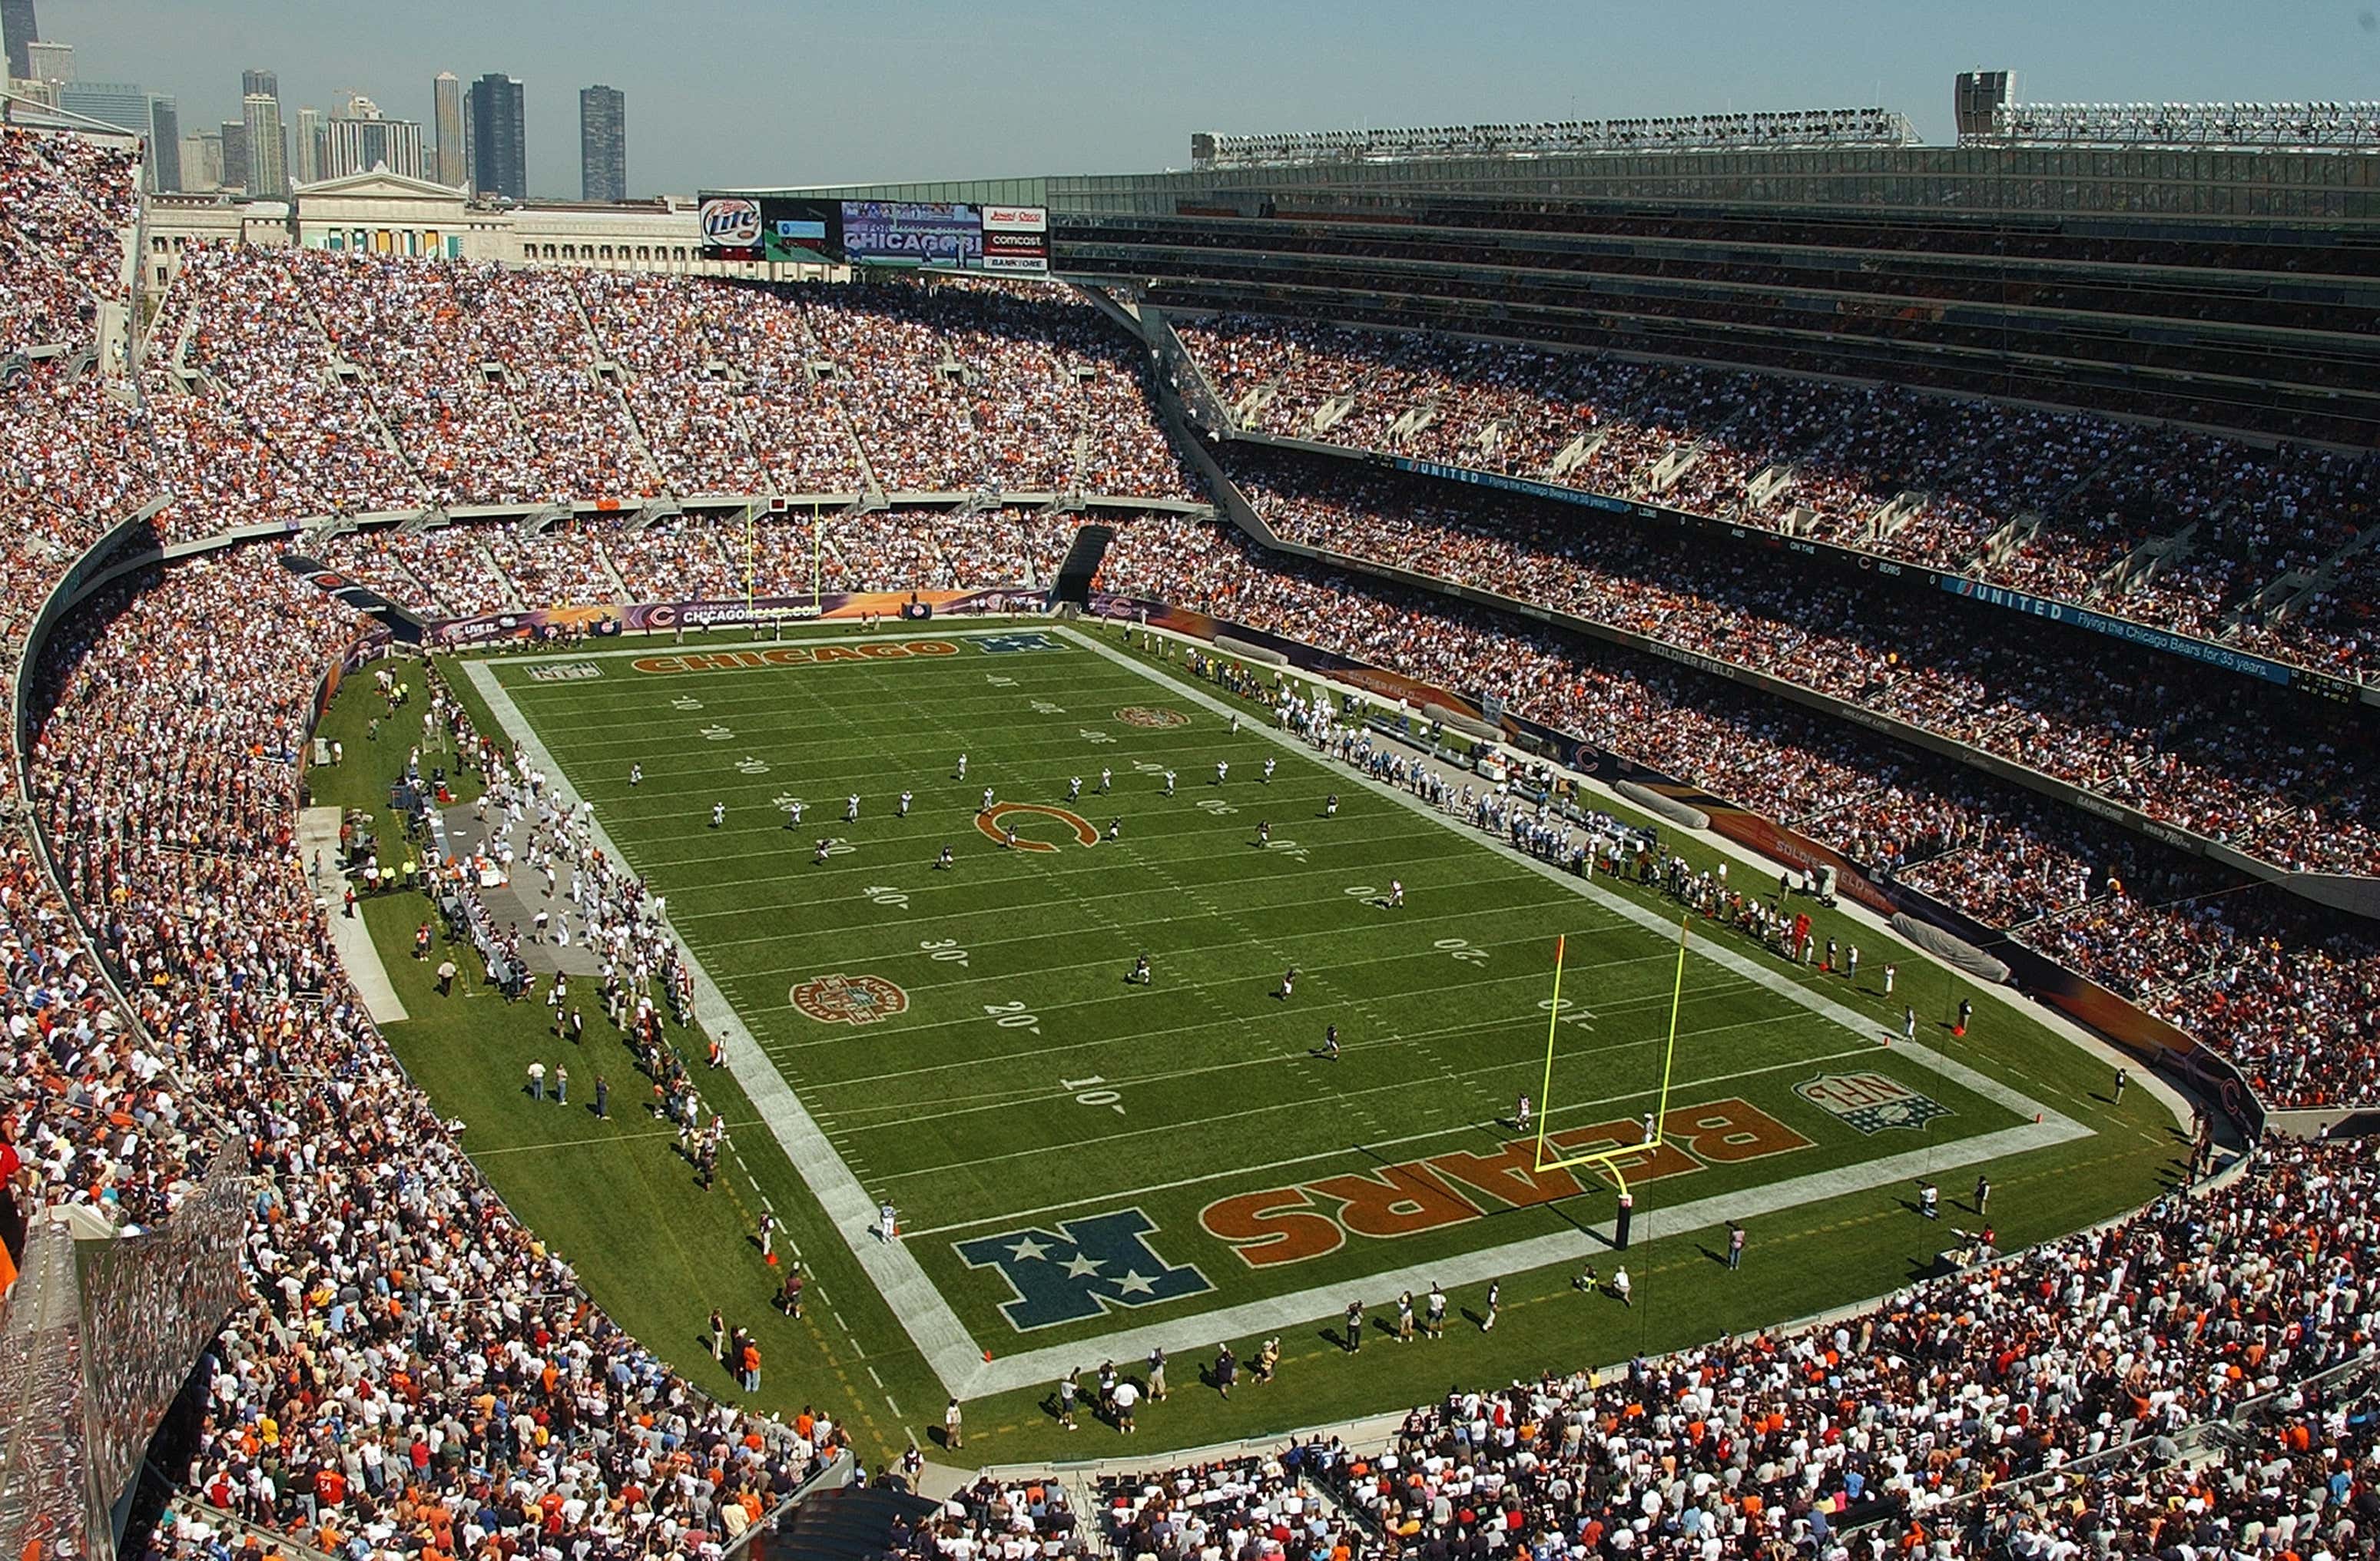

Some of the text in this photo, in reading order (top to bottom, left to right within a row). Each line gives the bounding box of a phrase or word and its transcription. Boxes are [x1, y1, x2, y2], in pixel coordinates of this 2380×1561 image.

[993, 235, 1043, 246] comcast
[1421, 464, 1479, 483] UNITED
[1976, 585, 2063, 620] UNITED
[2077, 611, 2107, 633] Flying
[2107, 618, 2123, 635] the
[2126, 625, 2168, 648] Chicago
[2170, 638, 2200, 658] Bears
[2203, 646, 2219, 661] for
[2219, 651, 2234, 666] 35
[631, 641, 960, 674] CHICAGO
[1649, 643, 1735, 678] SOLDIER FIELD
[1776, 840, 1828, 869] SOLDIE
[863, 886, 910, 904] 40
[920, 938, 969, 962] 30
[1434, 938, 1490, 961] 20
[984, 1001, 1039, 1028] 20
[1537, 998, 1598, 1024] 10
[1060, 1075, 1122, 1105] 10
[1805, 1075, 1911, 1108] NFL
[1198, 1096, 1818, 1269] BEARS
